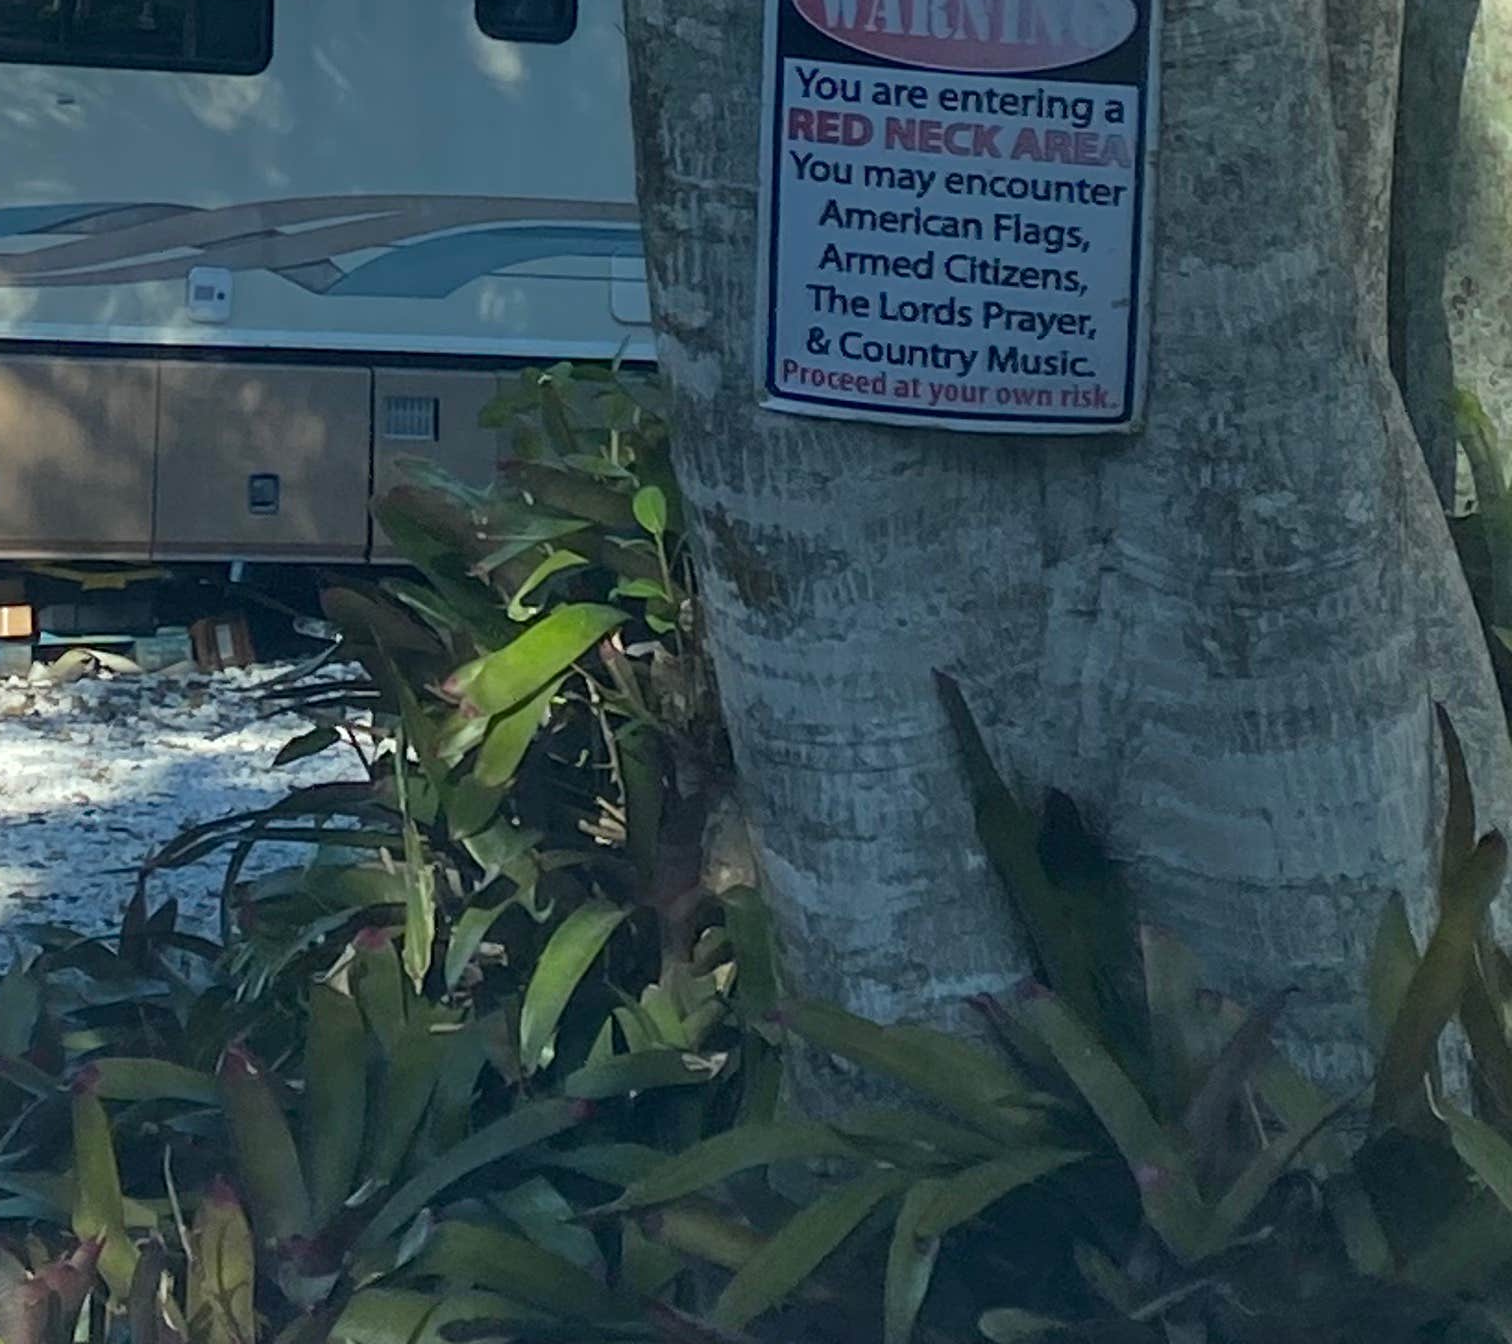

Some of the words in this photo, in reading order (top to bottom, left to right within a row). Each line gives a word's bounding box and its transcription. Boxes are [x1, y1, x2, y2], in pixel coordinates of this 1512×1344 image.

[794, 66, 862, 103] You
[872, 81, 928, 109] are
[939, 88, 1094, 128] entering
[1104, 99, 1125, 124] a
[788, 107, 873, 147] RED
[885, 116, 1004, 159] NECK
[1010, 127, 1132, 169] AREA
[789, 150, 853, 185] You
[863, 165, 936, 198] may
[945, 171, 1127, 206] encounter
[819, 199, 982, 240] American
[993, 213, 1090, 253] Flags,
[818, 243, 934, 280] Armed
[944, 254, 1088, 297] Citizens,
[806, 284, 870, 317] The
[880, 291, 972, 327] Lords
[983, 301, 1096, 340] Prayer,
[807, 326, 831, 355] &
[840, 332, 978, 377] Country
[988, 345, 1096, 377] Music.
[783, 359, 886, 396] Proceed
[894, 378, 920, 398] at
[929, 382, 991, 406] your
[996, 387, 1052, 406] own
[1061, 383, 1120, 409] risk.
